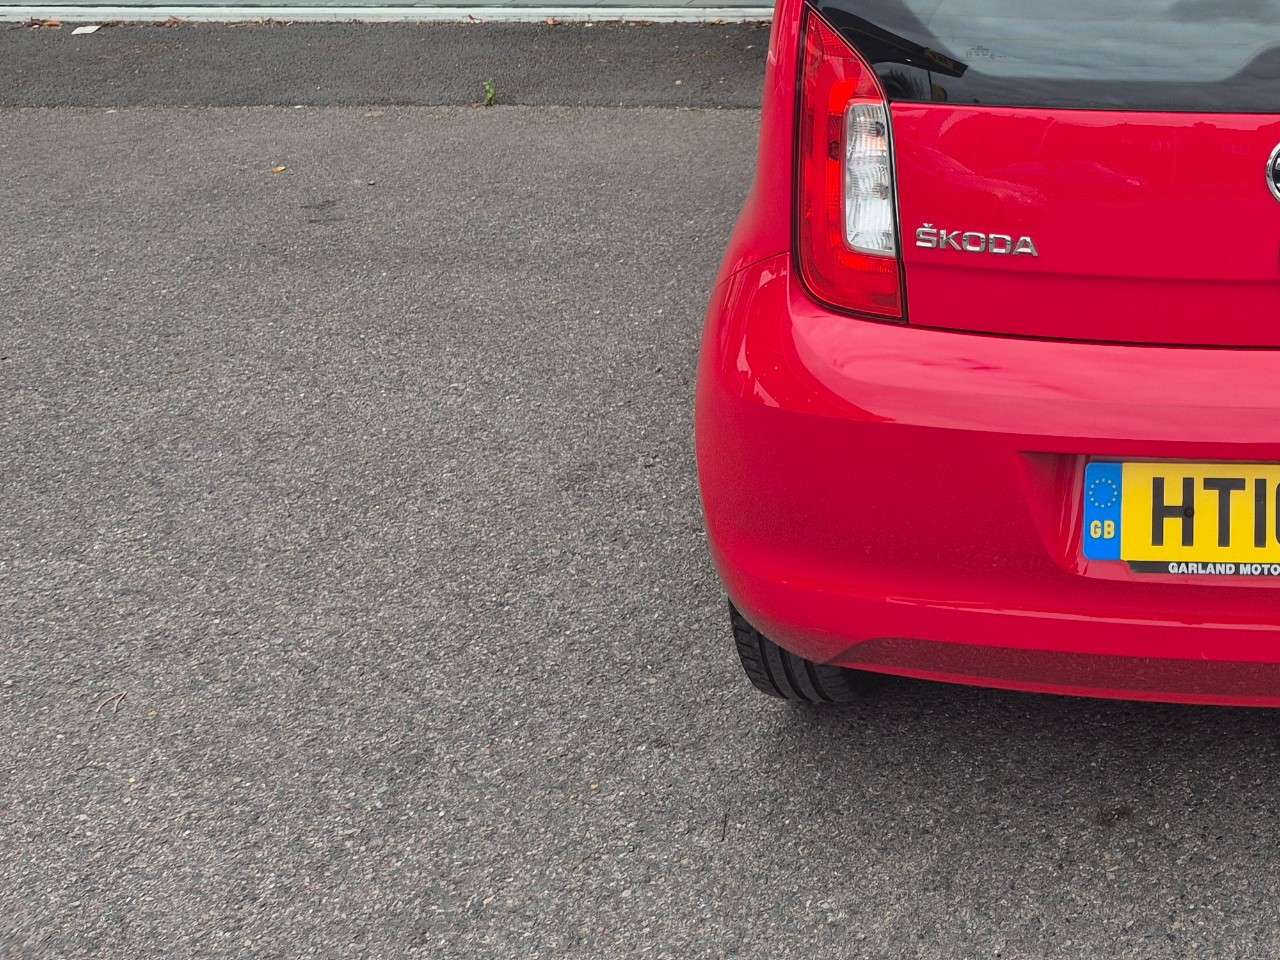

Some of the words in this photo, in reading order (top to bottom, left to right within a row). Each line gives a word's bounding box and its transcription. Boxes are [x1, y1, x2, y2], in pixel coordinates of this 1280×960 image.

[915, 222, 1039, 257] ŠKODA
[1090, 520, 1115, 539] GB
[1168, 562, 1236, 575] GARLAND
